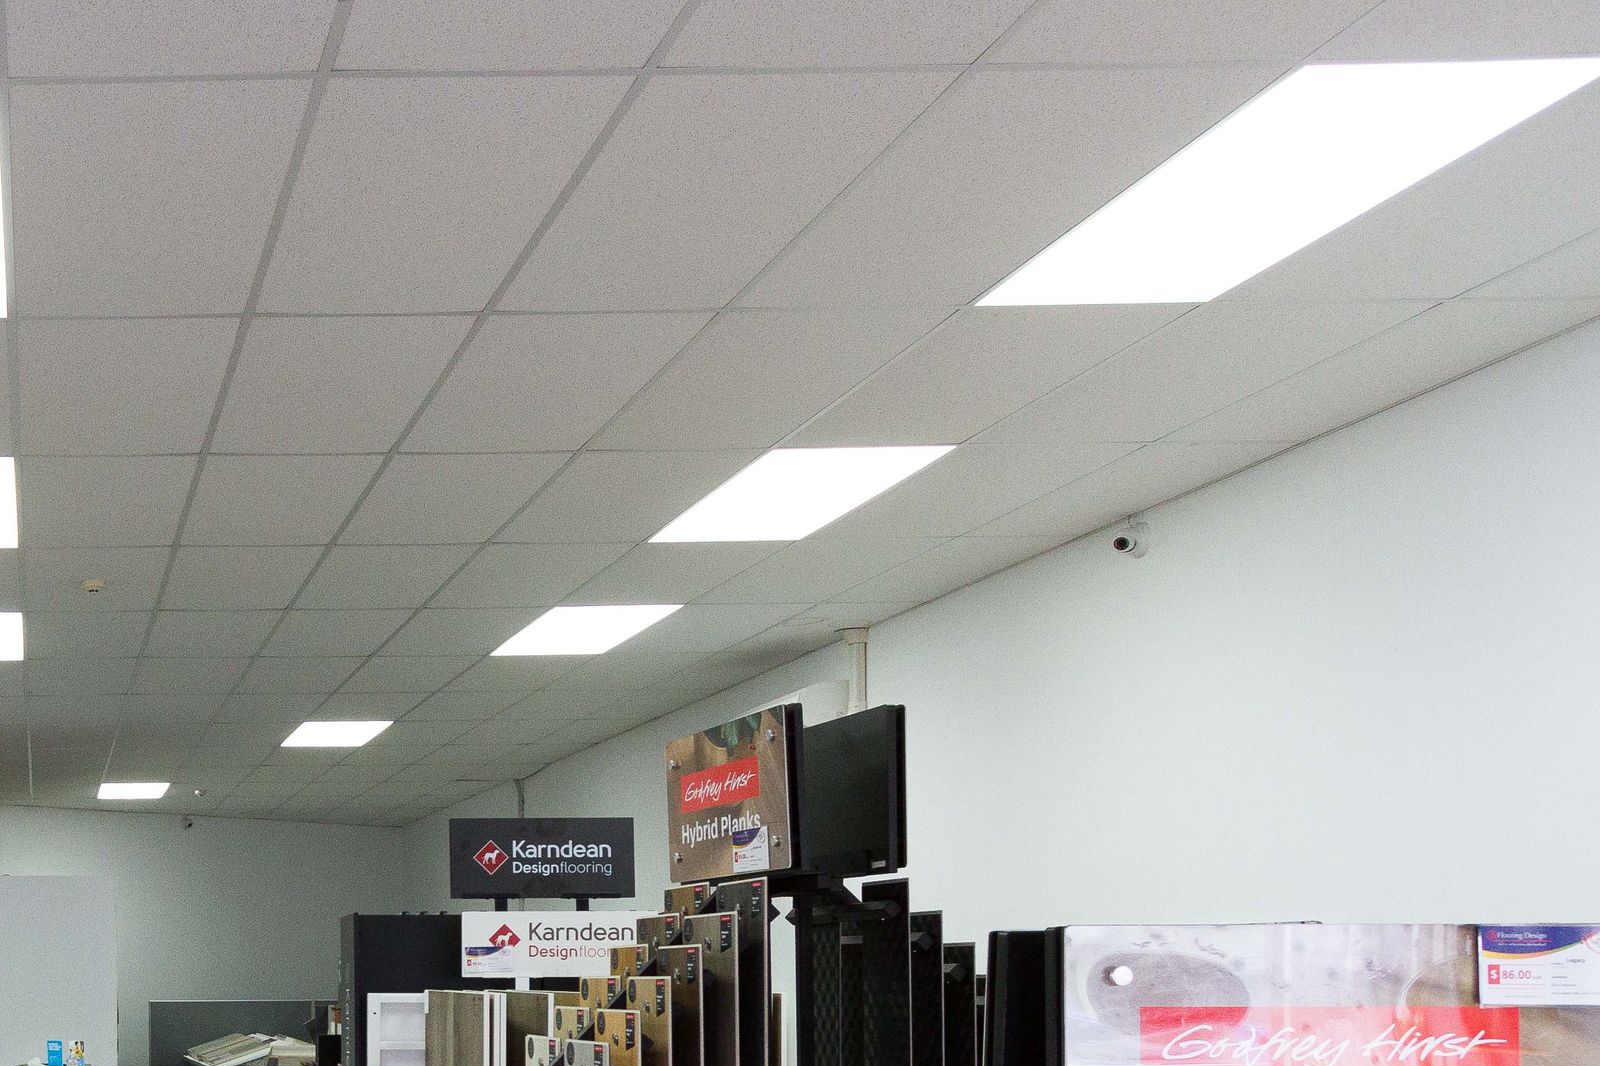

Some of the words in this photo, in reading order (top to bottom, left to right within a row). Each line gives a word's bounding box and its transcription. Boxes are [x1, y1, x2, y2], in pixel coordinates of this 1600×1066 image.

[684, 779, 722, 803] Godfrey
[723, 770, 757, 792] Hirst
[681, 817, 719, 849] Hybrid
[720, 810, 761, 837] Planks
[512, 840, 612, 859] Karndean
[512, 861, 613, 876] Designflooring
[528, 922, 634, 942] Karndean
[1497, 930, 1521, 941] Flooring
[1523, 930, 1547, 940] Design
[1501, 969, 1532, 980] 86.00
[1362, 1024, 1508, 1061] Hirst
